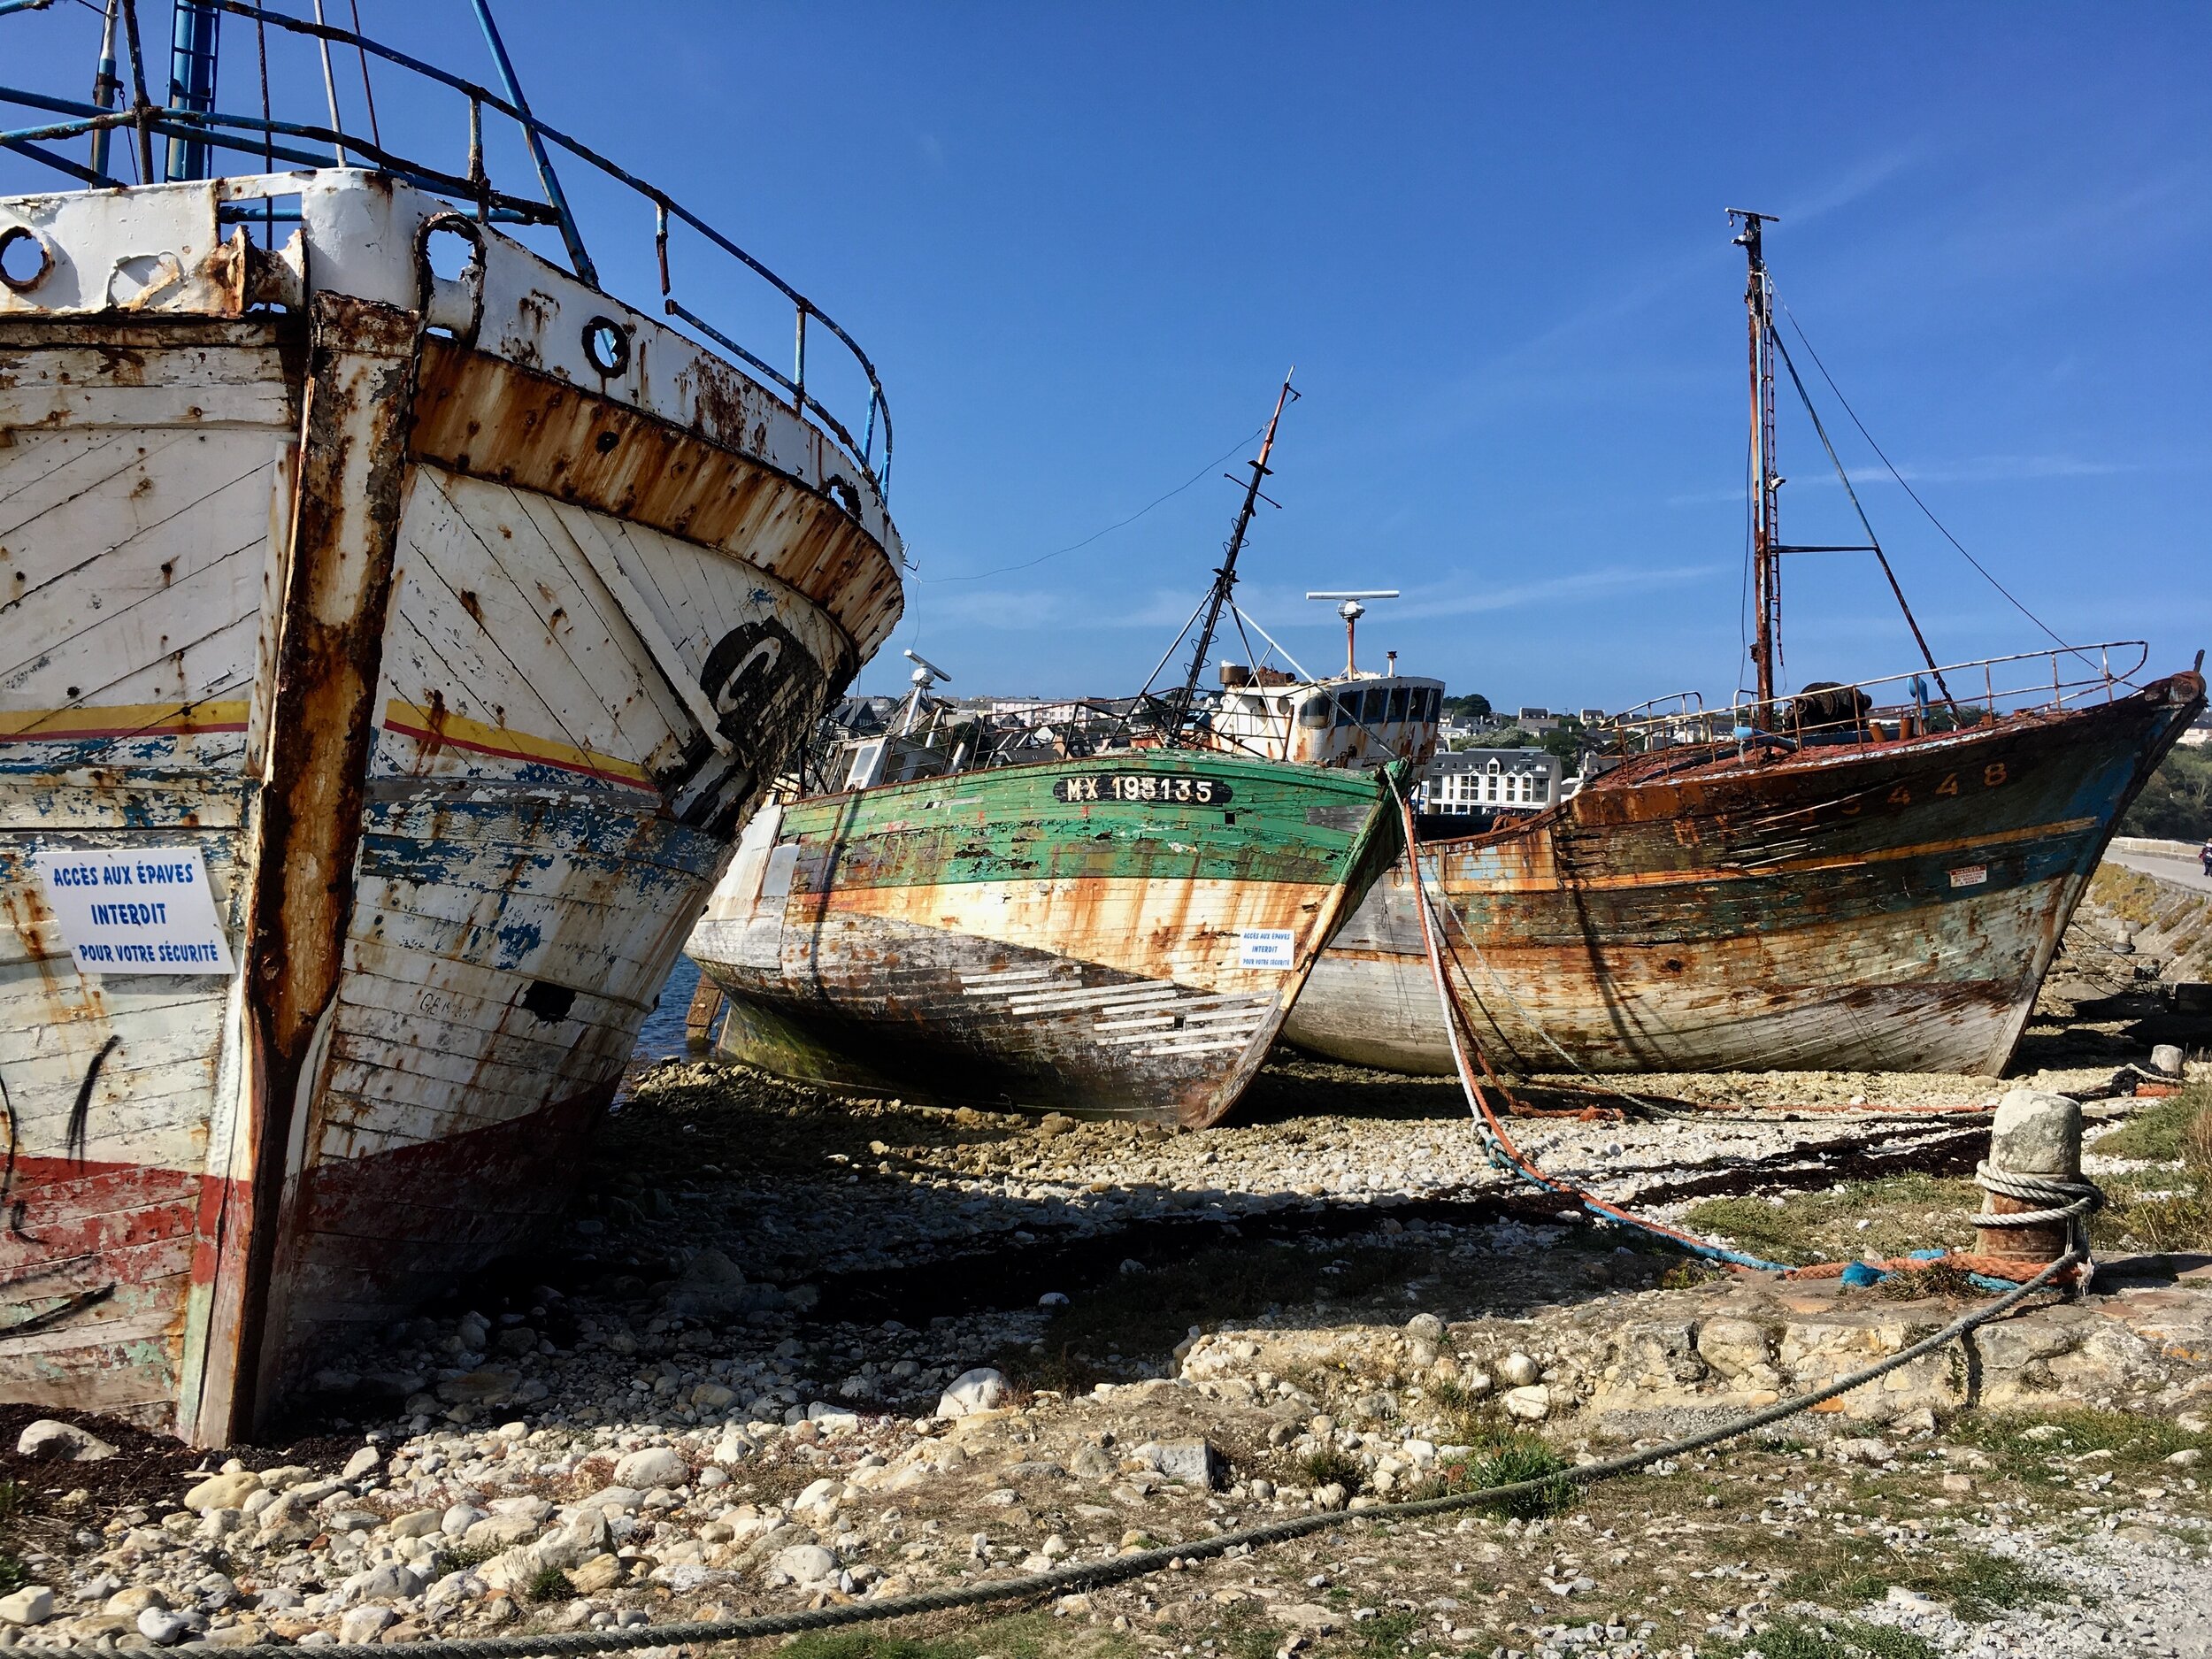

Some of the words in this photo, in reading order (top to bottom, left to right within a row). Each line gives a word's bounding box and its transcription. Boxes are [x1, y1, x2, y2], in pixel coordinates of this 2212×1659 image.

[1067, 778, 1098, 802] MX
[53, 862, 99, 887] ACCÈS
[103, 865, 133, 885] AUX
[136, 860, 194, 884] ÉPAVES
[90, 902, 166, 925] INTERDIT
[79, 944, 114, 962] POUR
[114, 944, 156, 963] VOTRE
[158, 940, 219, 963] SÉCURITÉ
